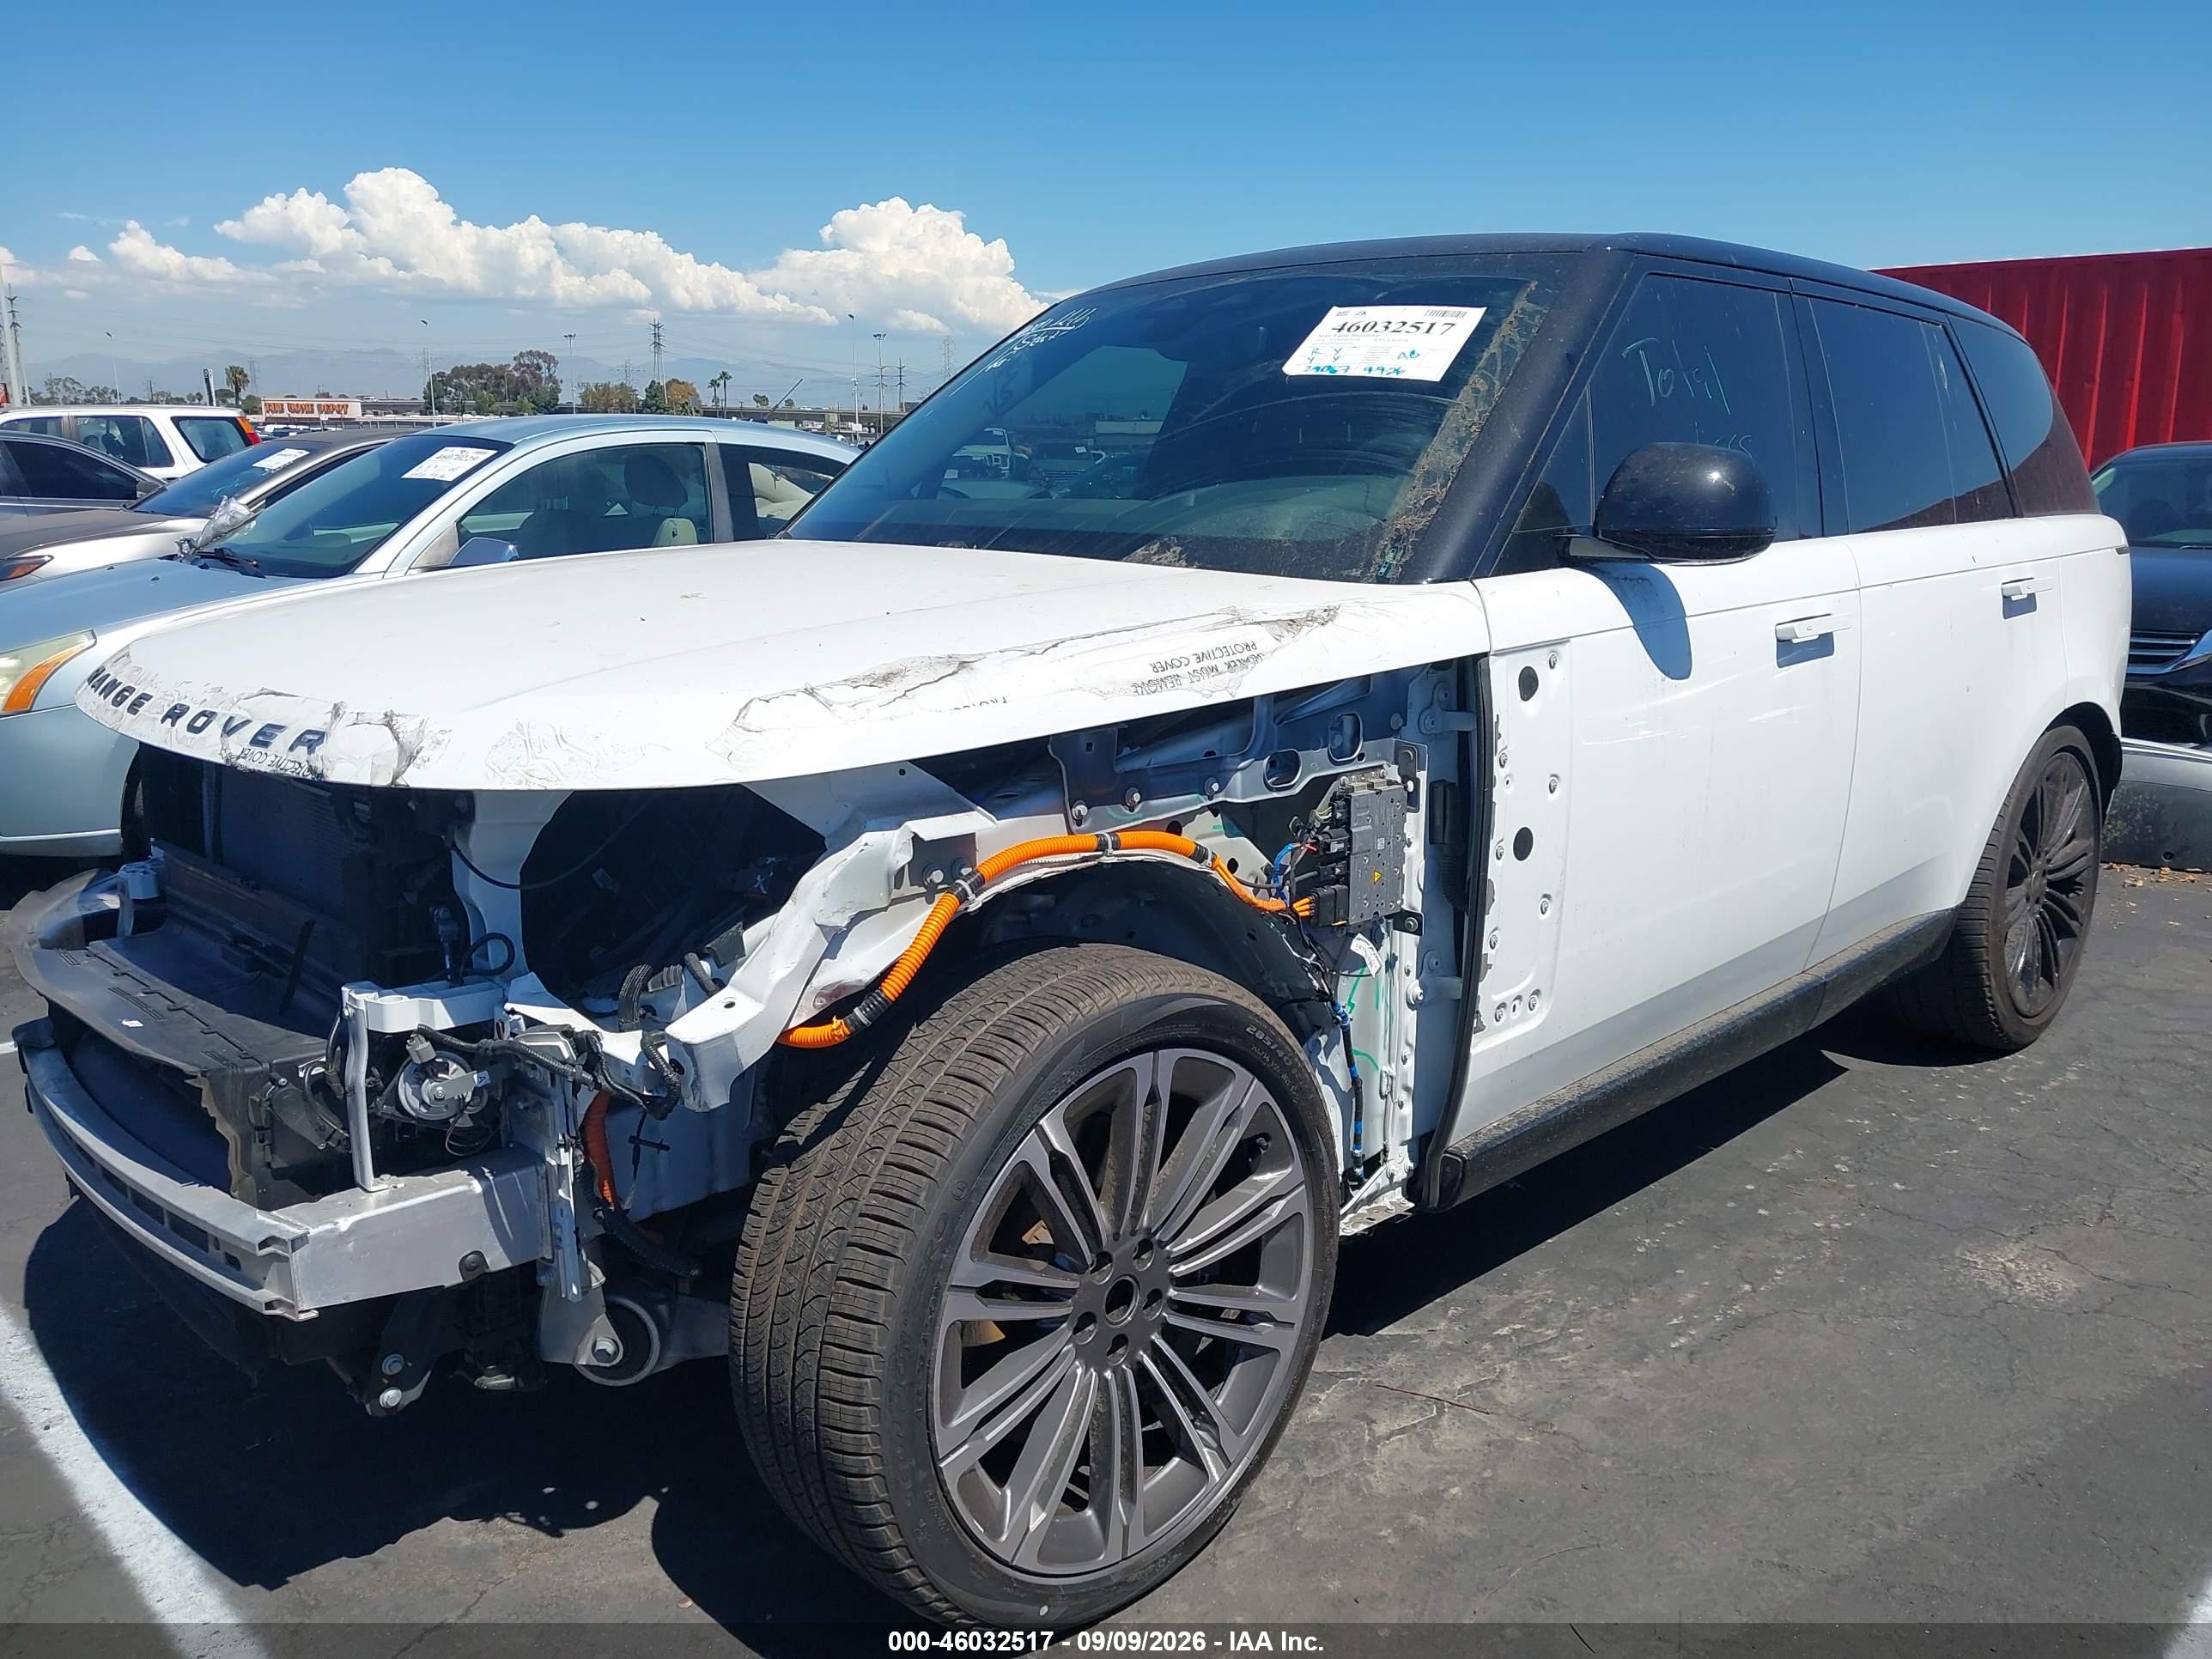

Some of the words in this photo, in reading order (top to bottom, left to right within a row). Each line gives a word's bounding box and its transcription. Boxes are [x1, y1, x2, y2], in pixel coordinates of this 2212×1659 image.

[1332, 320, 1456, 336] 46032517
[264, 402, 284, 414] THE
[288, 403, 314, 415] HOME
[317, 404, 349, 416] DEPOT
[1192, 641, 1258, 664] PROTECTIVE
[1149, 655, 1190, 673] COVER
[1187, 664, 1219, 684] MUST
[86, 665, 153, 716] RANGE
[160, 702, 326, 755] ROVER
